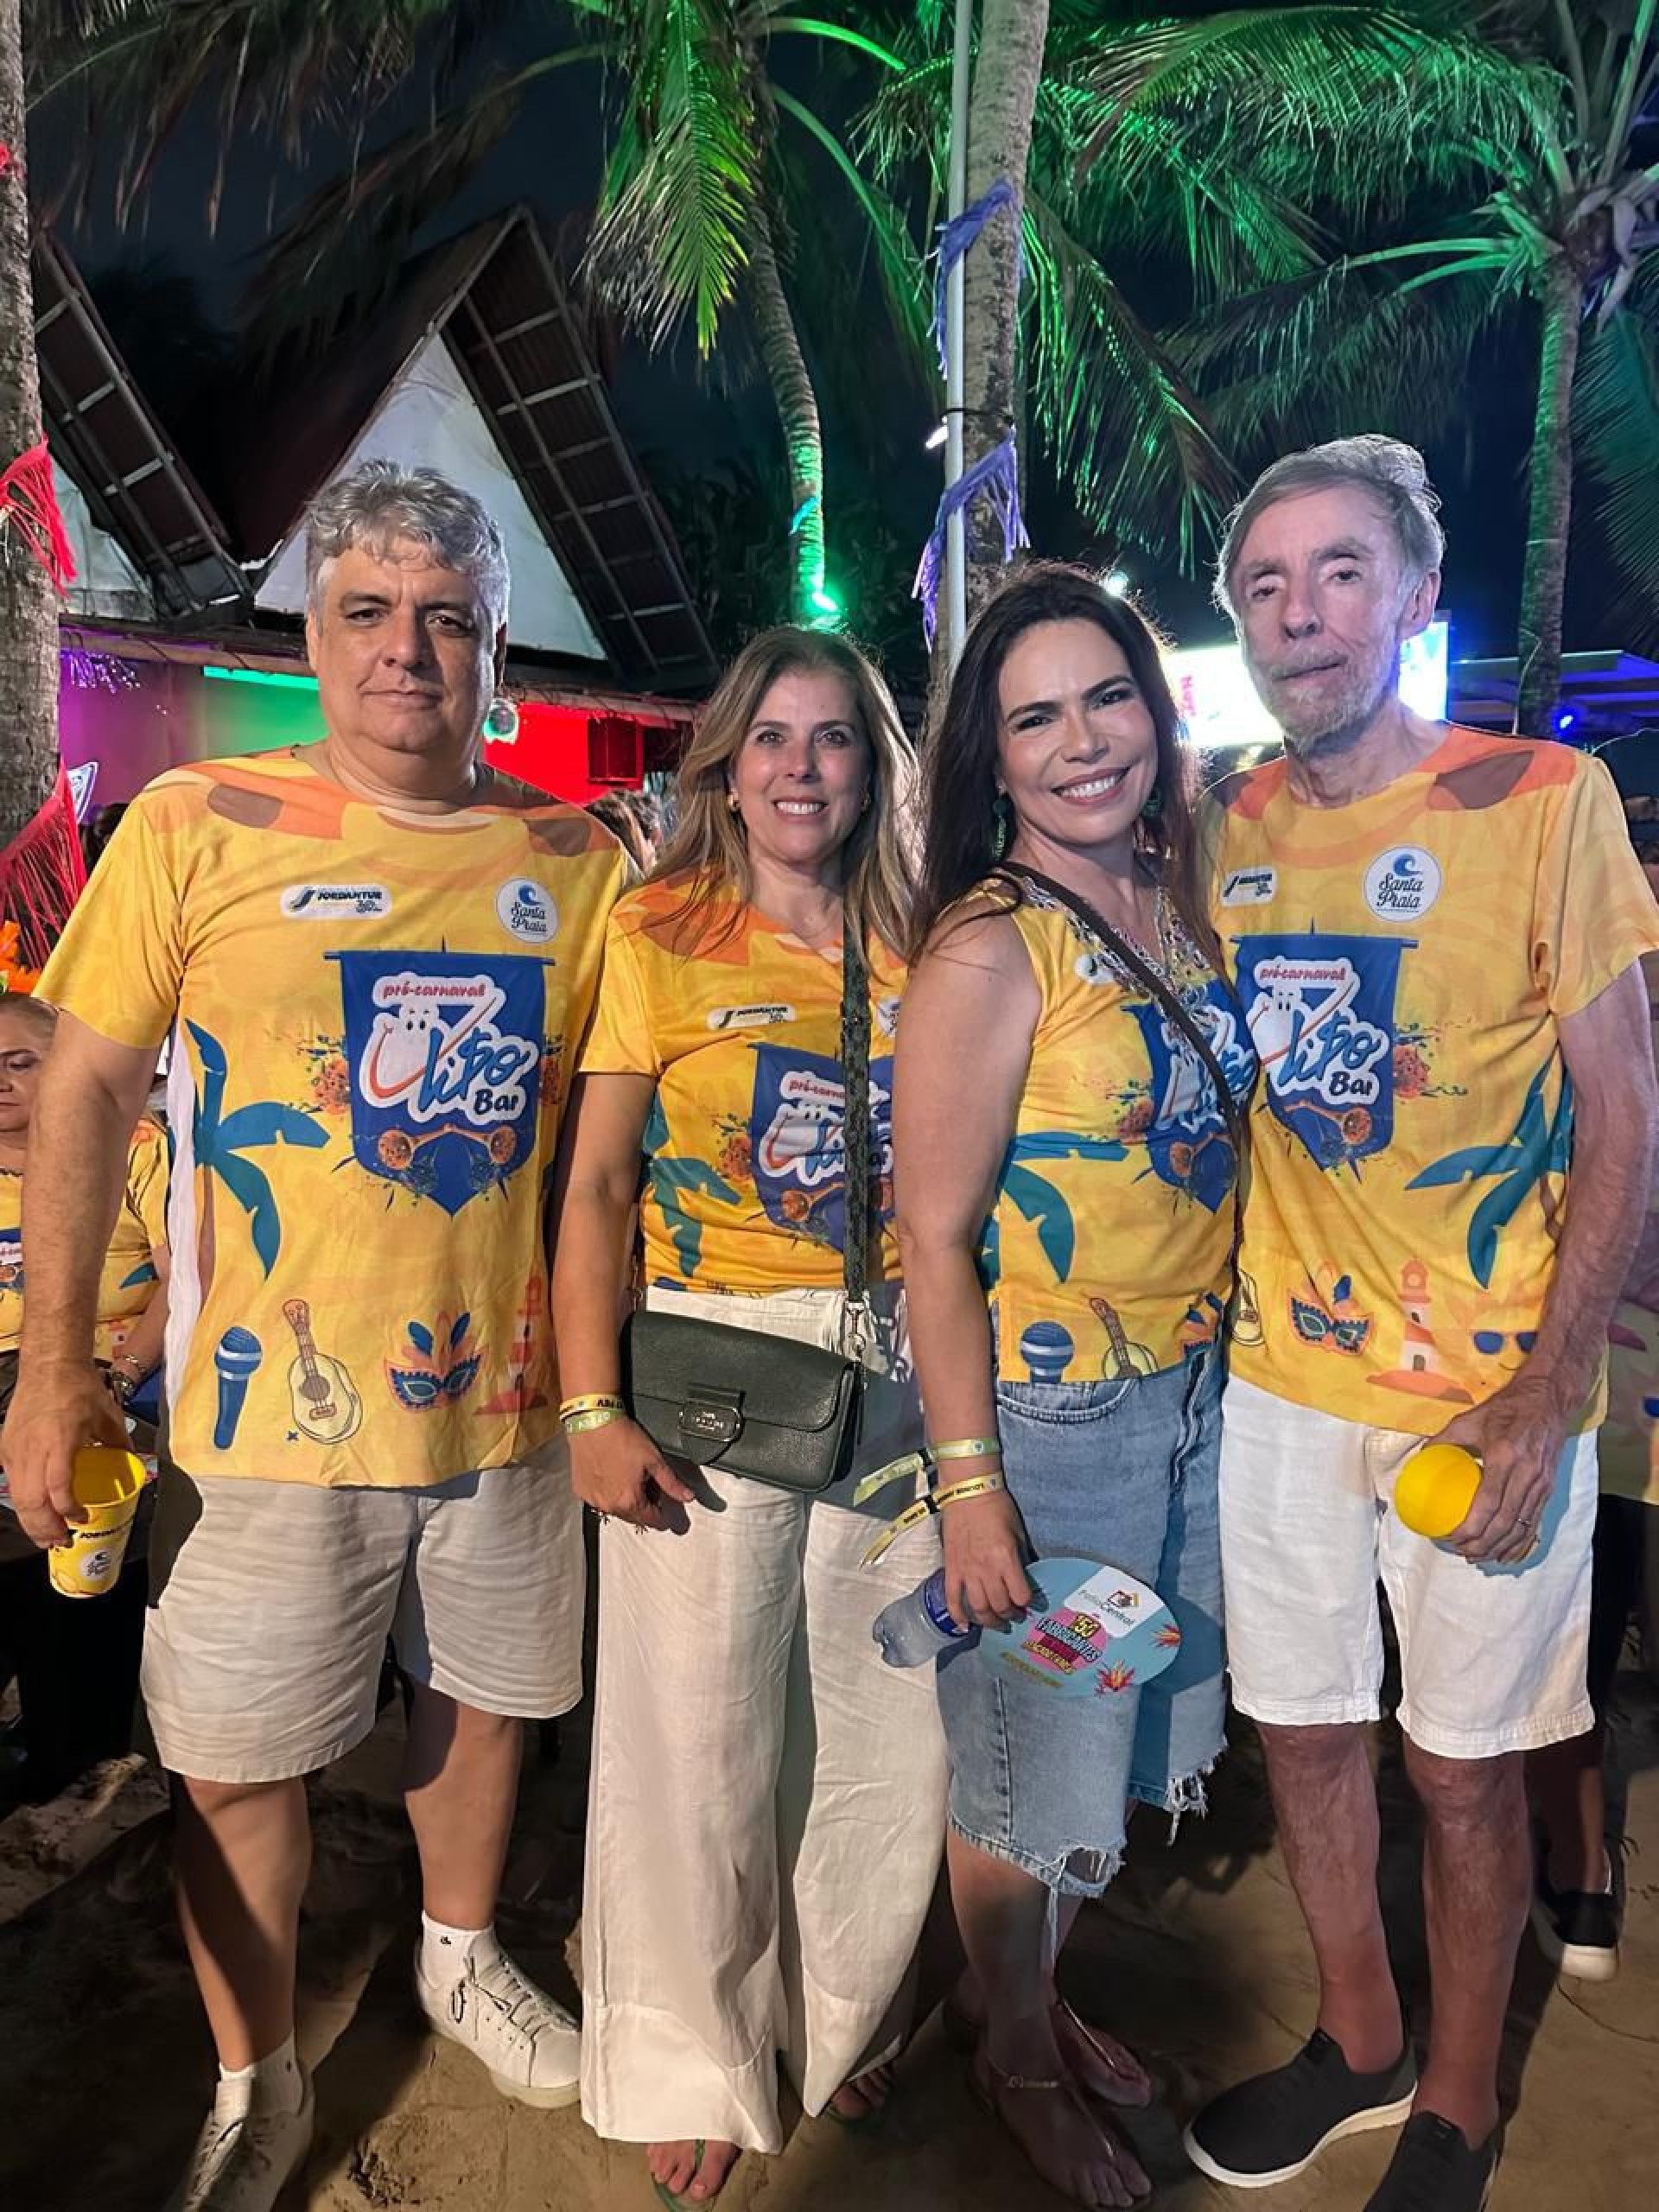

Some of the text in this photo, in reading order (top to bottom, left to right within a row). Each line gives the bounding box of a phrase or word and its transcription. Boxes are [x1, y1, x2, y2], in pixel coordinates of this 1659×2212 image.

[1379, 873, 1422, 893] Santa
[1376, 892, 1421, 908] Praia
[1259, 963, 1345, 981] pré-carnaval
[383, 980, 487, 1000] pré-carnaval
[1329, 1071, 1373, 1096] Bar
[475, 1089, 519, 1115] Bar
